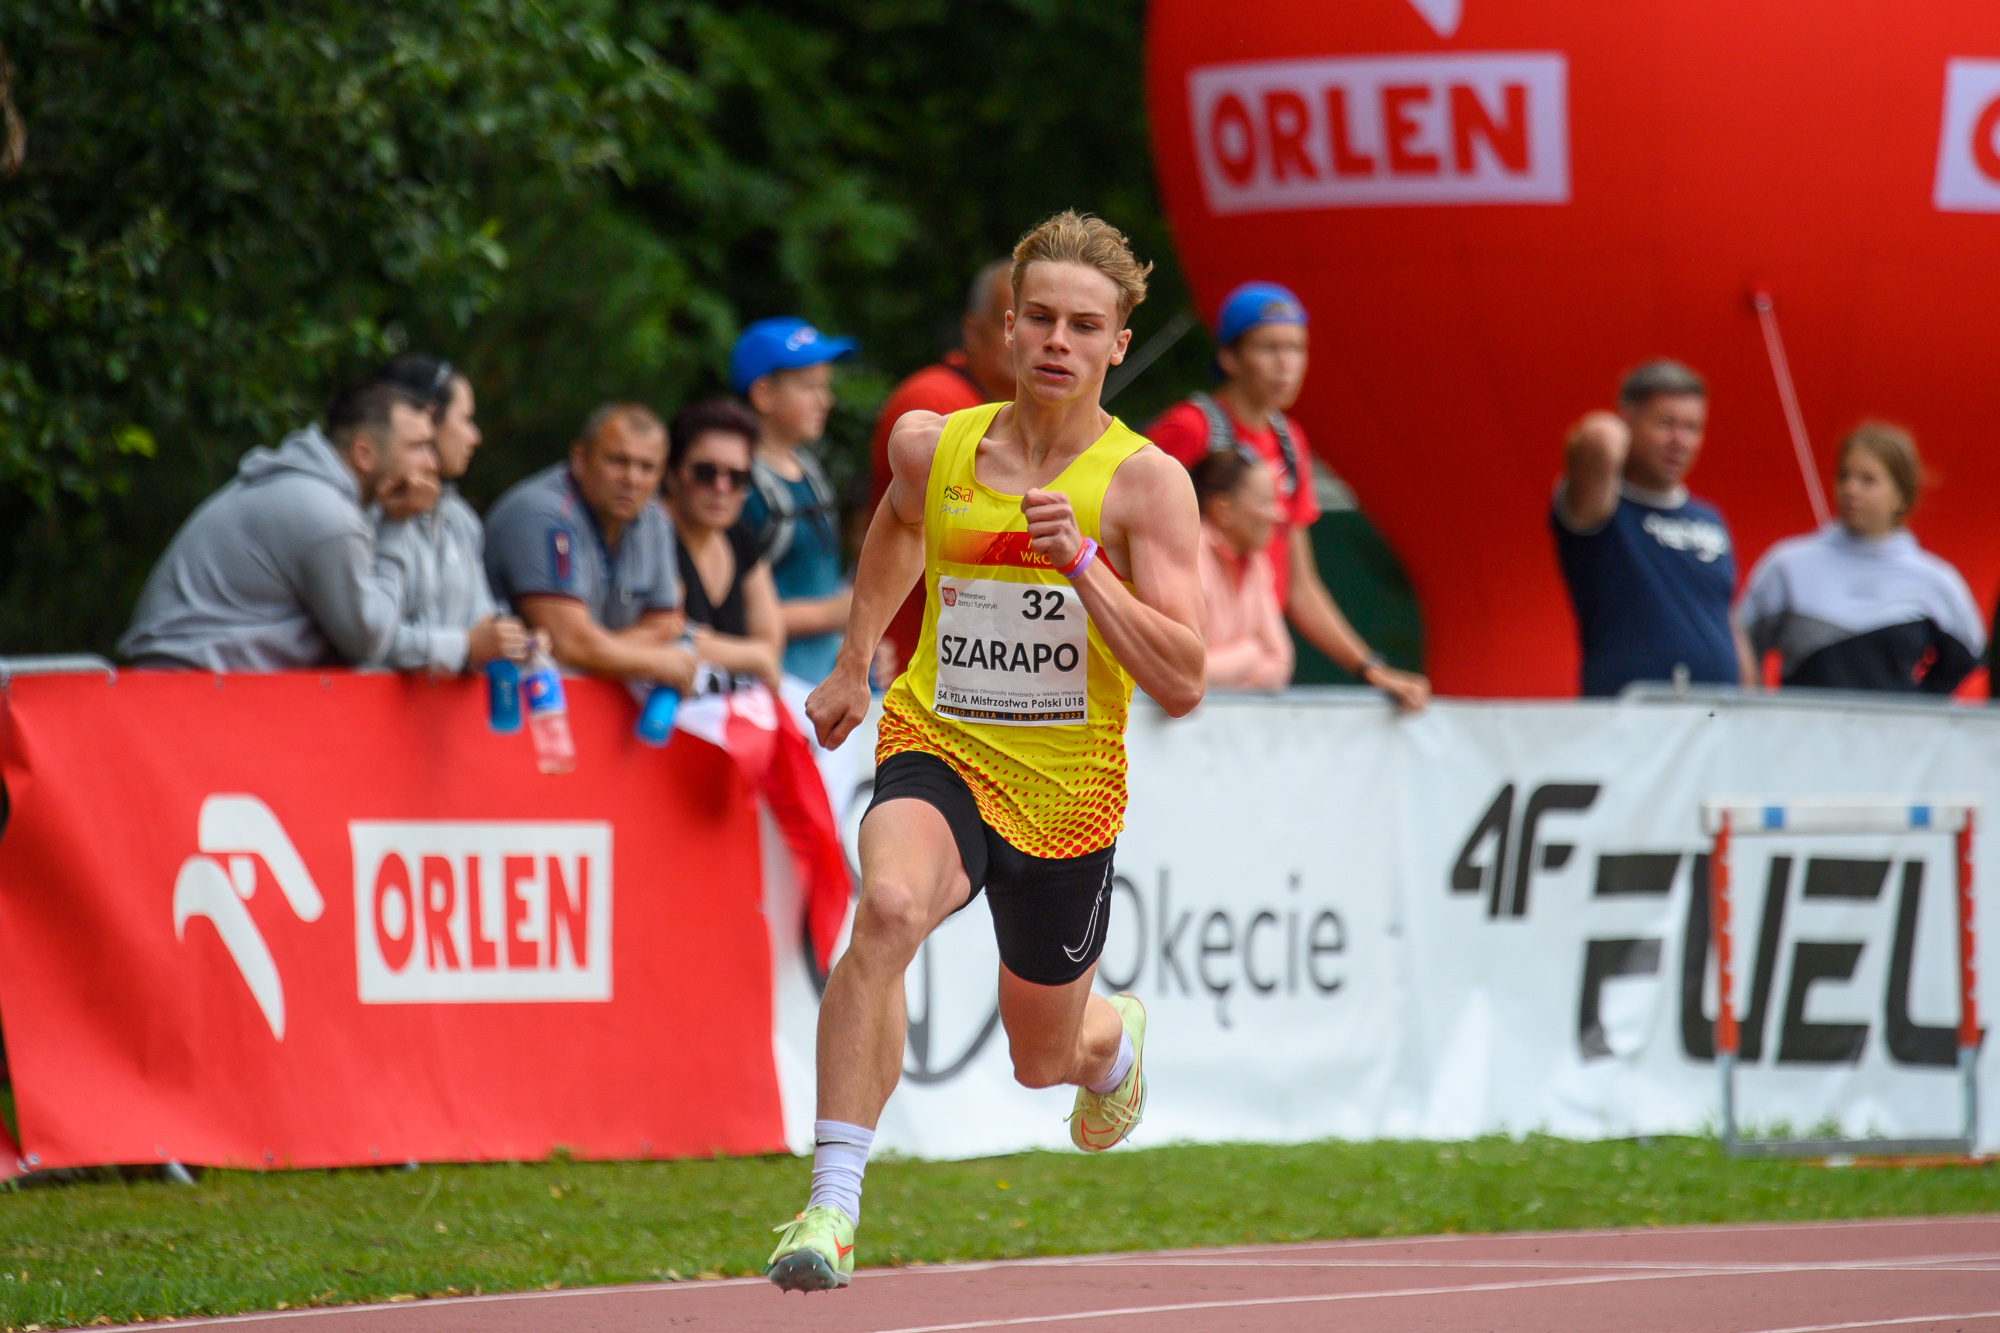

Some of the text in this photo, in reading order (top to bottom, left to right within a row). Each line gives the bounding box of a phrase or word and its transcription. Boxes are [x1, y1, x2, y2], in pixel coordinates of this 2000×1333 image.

[1209, 81, 1531, 189] ORLEN
[941, 634, 1079, 673] SZARAPO
[1021, 589, 1065, 621] 32
[937, 690, 1085, 709] 54. PZLA Mistrzostwa Polski U18
[1012, 712, 1082, 721] 15-17.07.2022
[1449, 781, 1604, 919] 4F
[372, 851, 590, 976] ORLEN
[1098, 867, 1349, 1029] Okęcie
[1579, 852, 1988, 1067] FUEL
